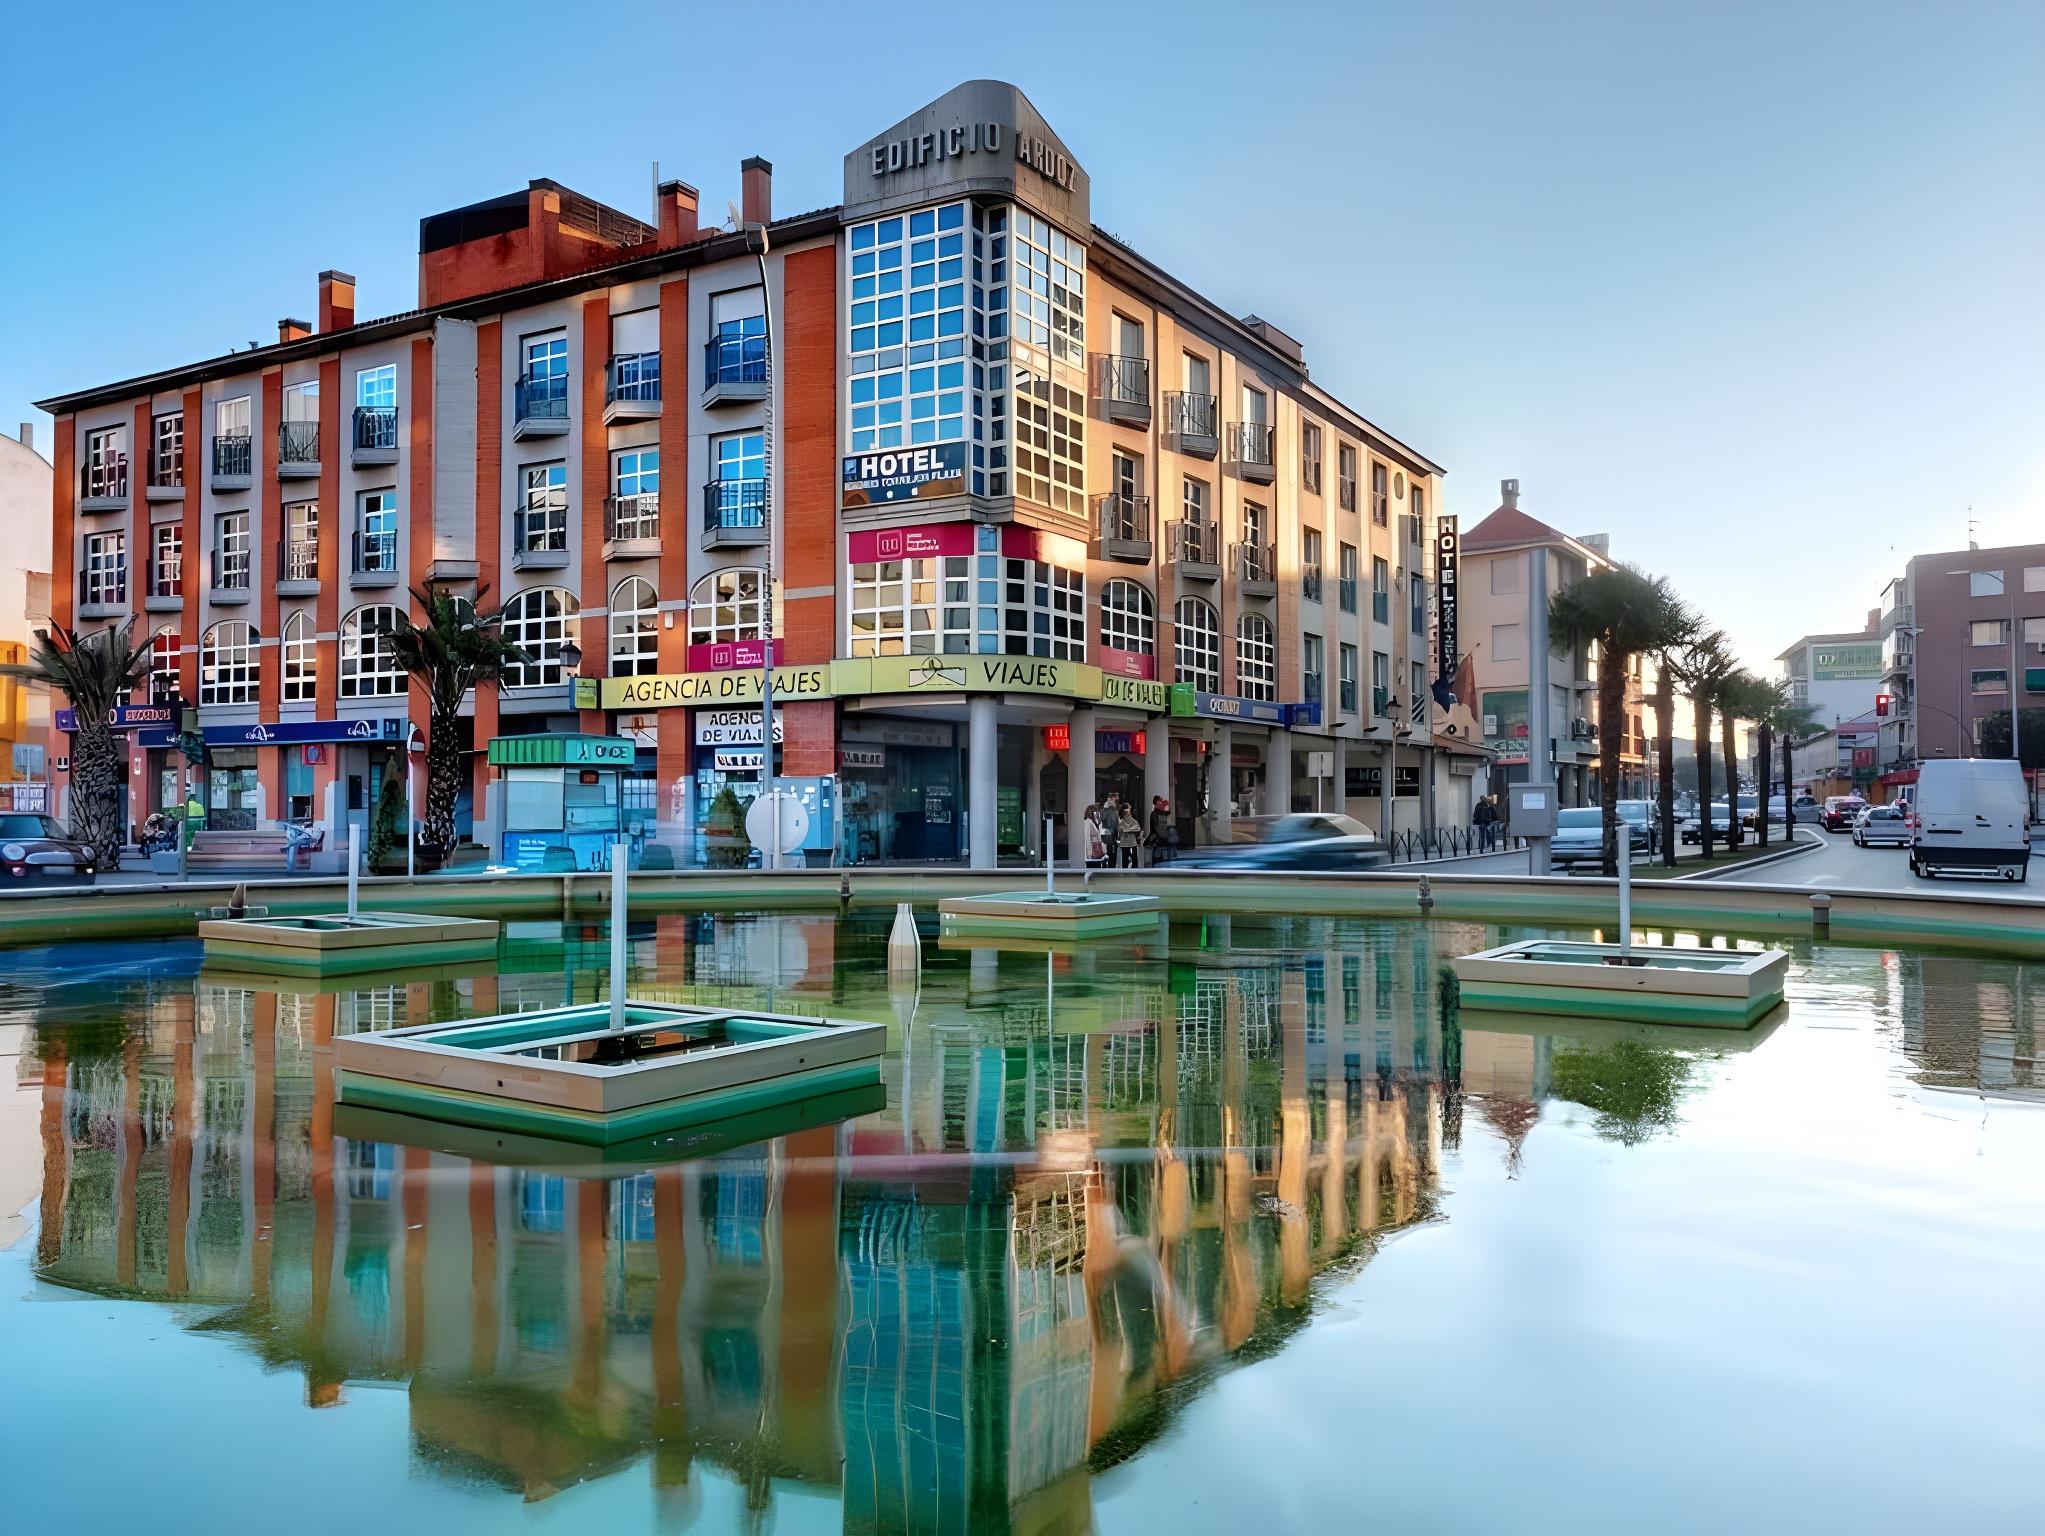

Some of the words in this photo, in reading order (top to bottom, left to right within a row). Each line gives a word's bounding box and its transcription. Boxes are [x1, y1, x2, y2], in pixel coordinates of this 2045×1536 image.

[871, 121, 1000, 177] EDIFICIO
[861, 448, 944, 478] HOTEL
[1440, 516, 1455, 601] HOTEL
[622, 678, 712, 703] AGENCIA
[720, 676, 746, 697] DE
[753, 671, 821, 696] VAJES
[983, 661, 1058, 688] VIAJES
